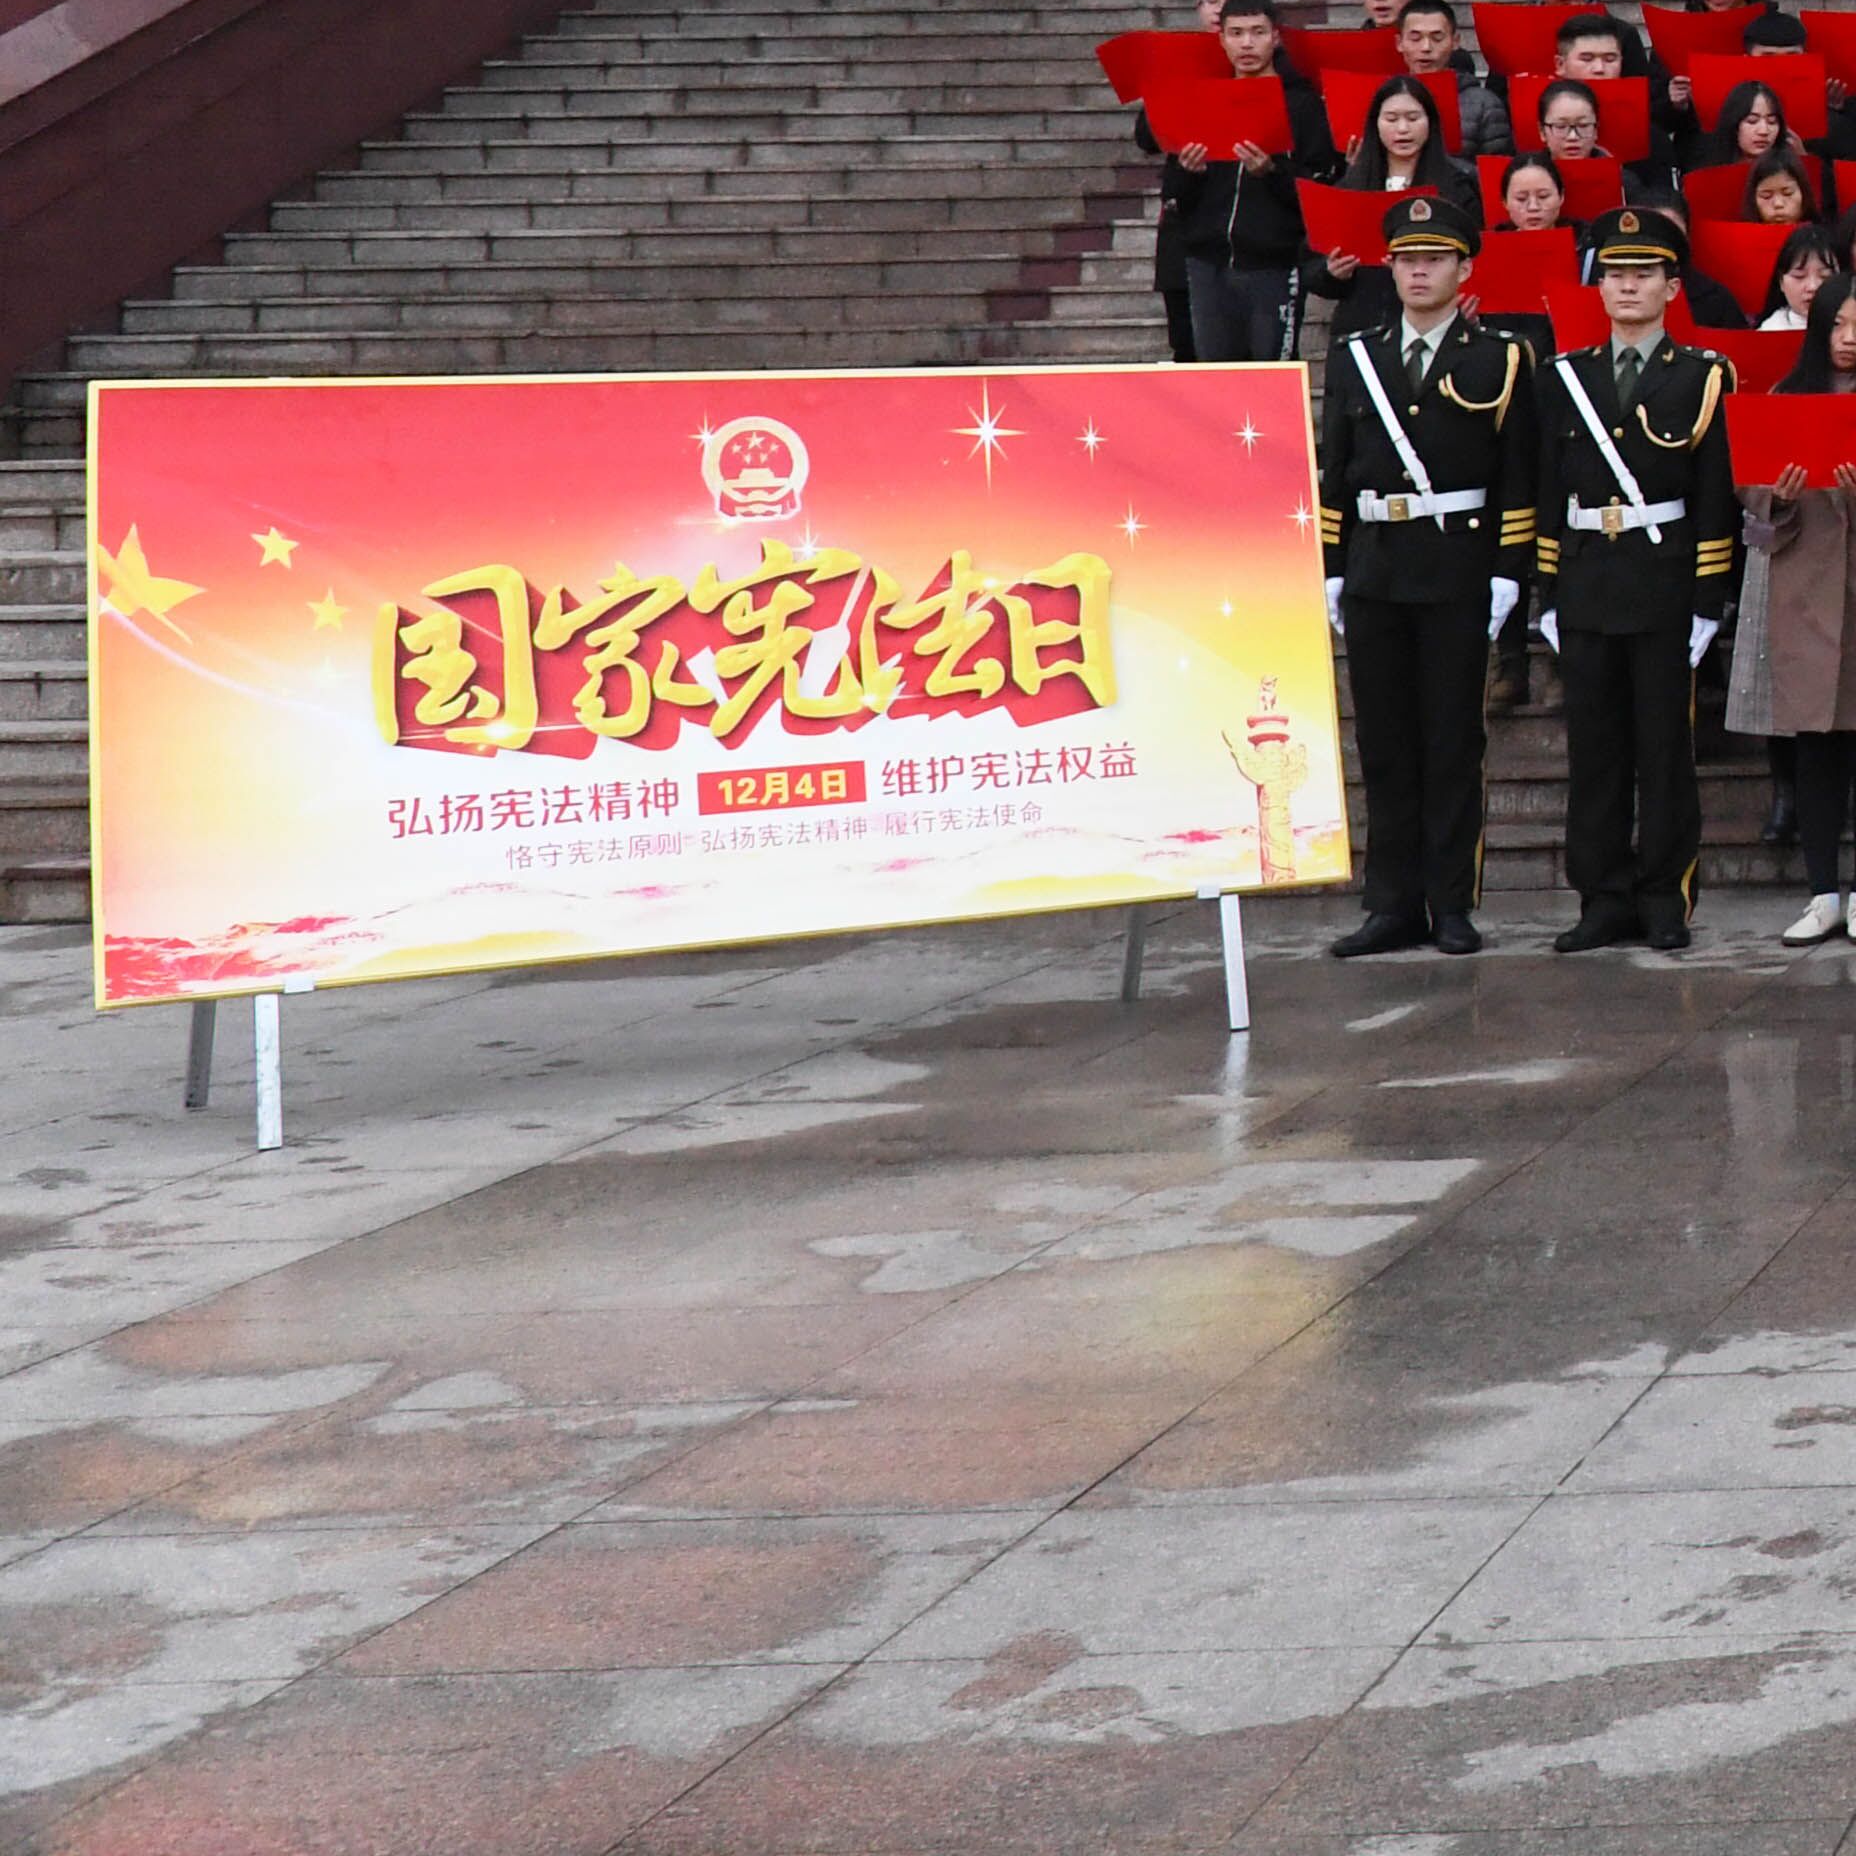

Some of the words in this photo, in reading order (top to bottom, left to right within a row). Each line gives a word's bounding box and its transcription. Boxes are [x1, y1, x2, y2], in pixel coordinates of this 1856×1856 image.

[370, 538, 1119, 750] 国家宪法日
[387, 776, 680, 839] 弘扬宪法精神
[716, 768, 848, 807] 12月4日
[881, 740, 1138, 798] 维护宪法权益
[700, 815, 868, 854] 弘扬宪法精神
